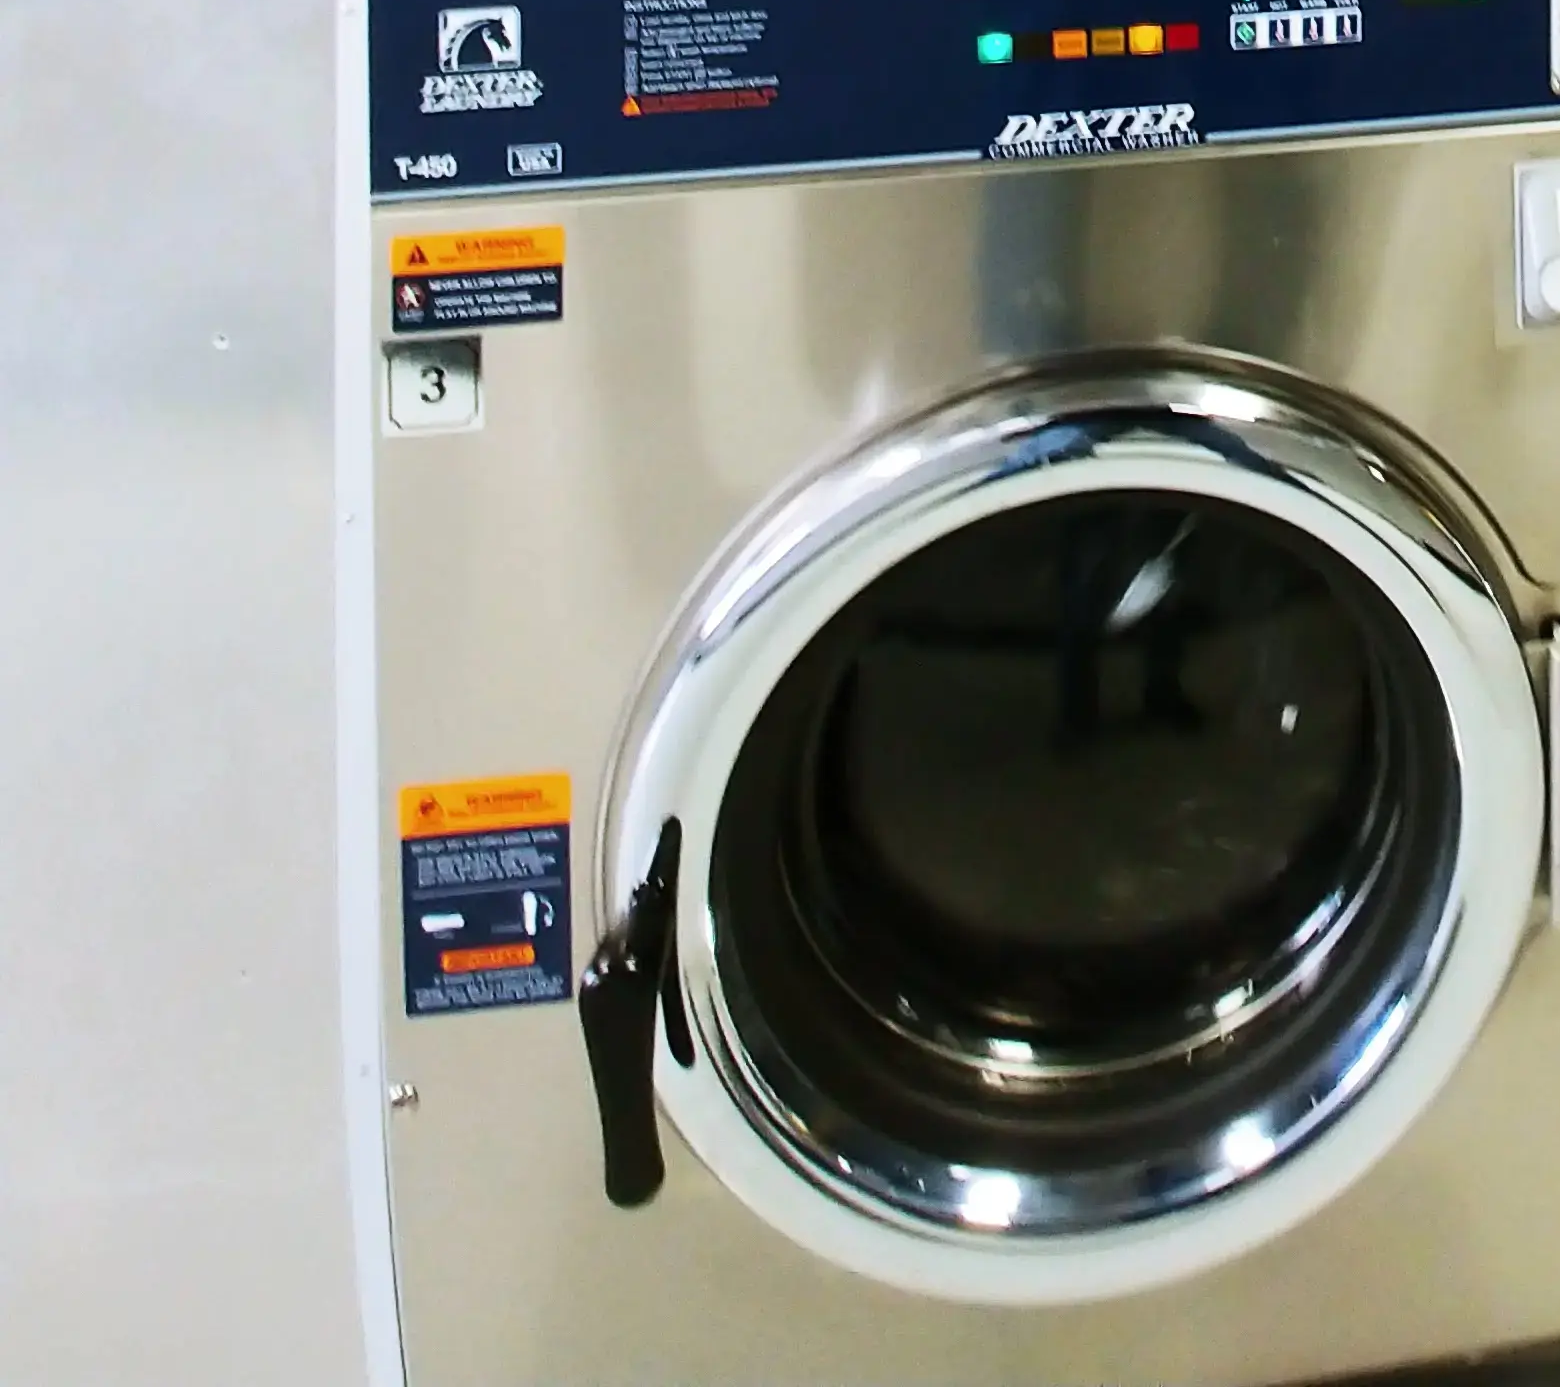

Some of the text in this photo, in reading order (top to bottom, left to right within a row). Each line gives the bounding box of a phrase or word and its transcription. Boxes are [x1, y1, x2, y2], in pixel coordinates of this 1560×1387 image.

[419, 70, 544, 97] DEXTER
[994, 102, 1196, 146] DEXTER
[393, 152, 458, 181] T-450
[420, 365, 447, 403] 3
